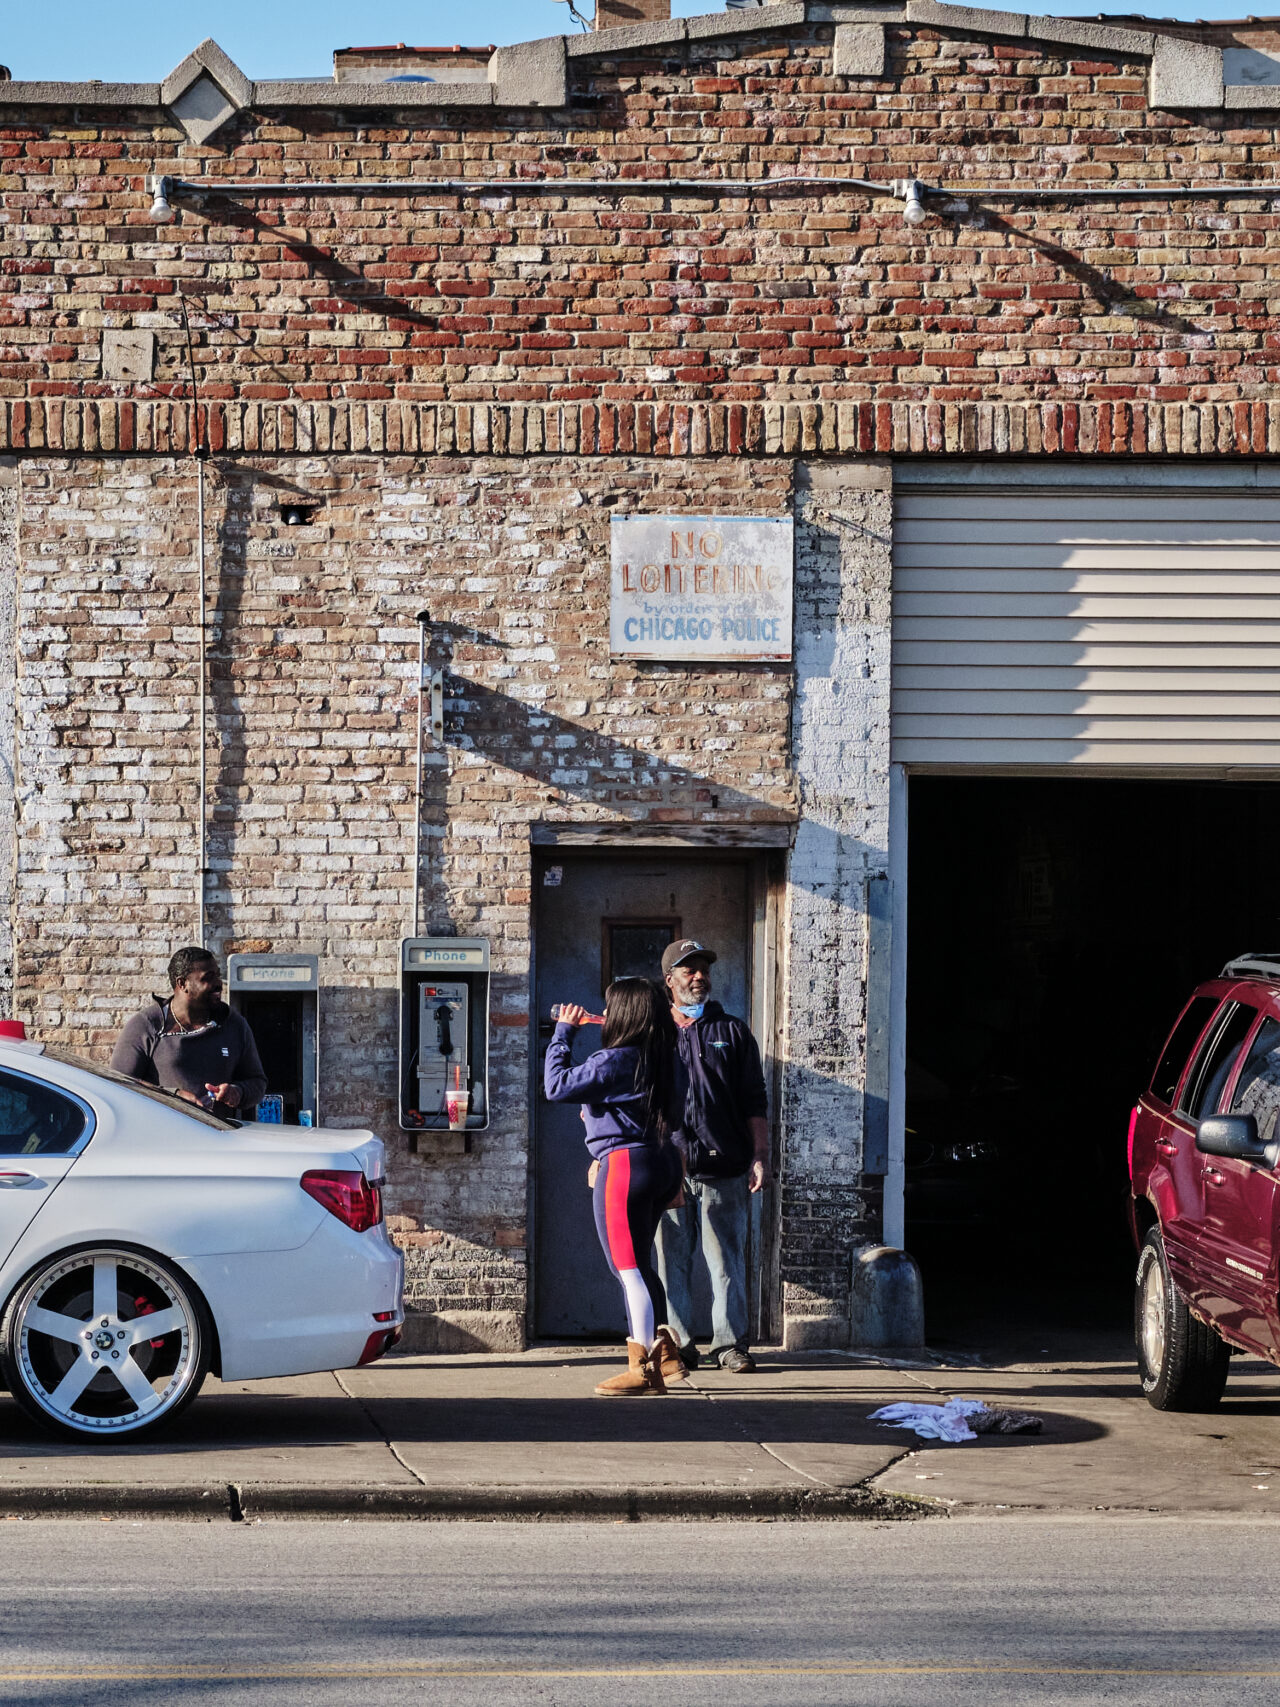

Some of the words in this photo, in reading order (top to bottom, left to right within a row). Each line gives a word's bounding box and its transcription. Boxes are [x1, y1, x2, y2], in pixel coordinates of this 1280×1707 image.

[671, 531, 723, 559] NO
[621, 564, 784, 594] LOITERING
[644, 602, 663, 617] by
[623, 617, 712, 642] CHICAGO
[721, 617, 781, 642] POLICE
[424, 950, 467, 961] Phone
